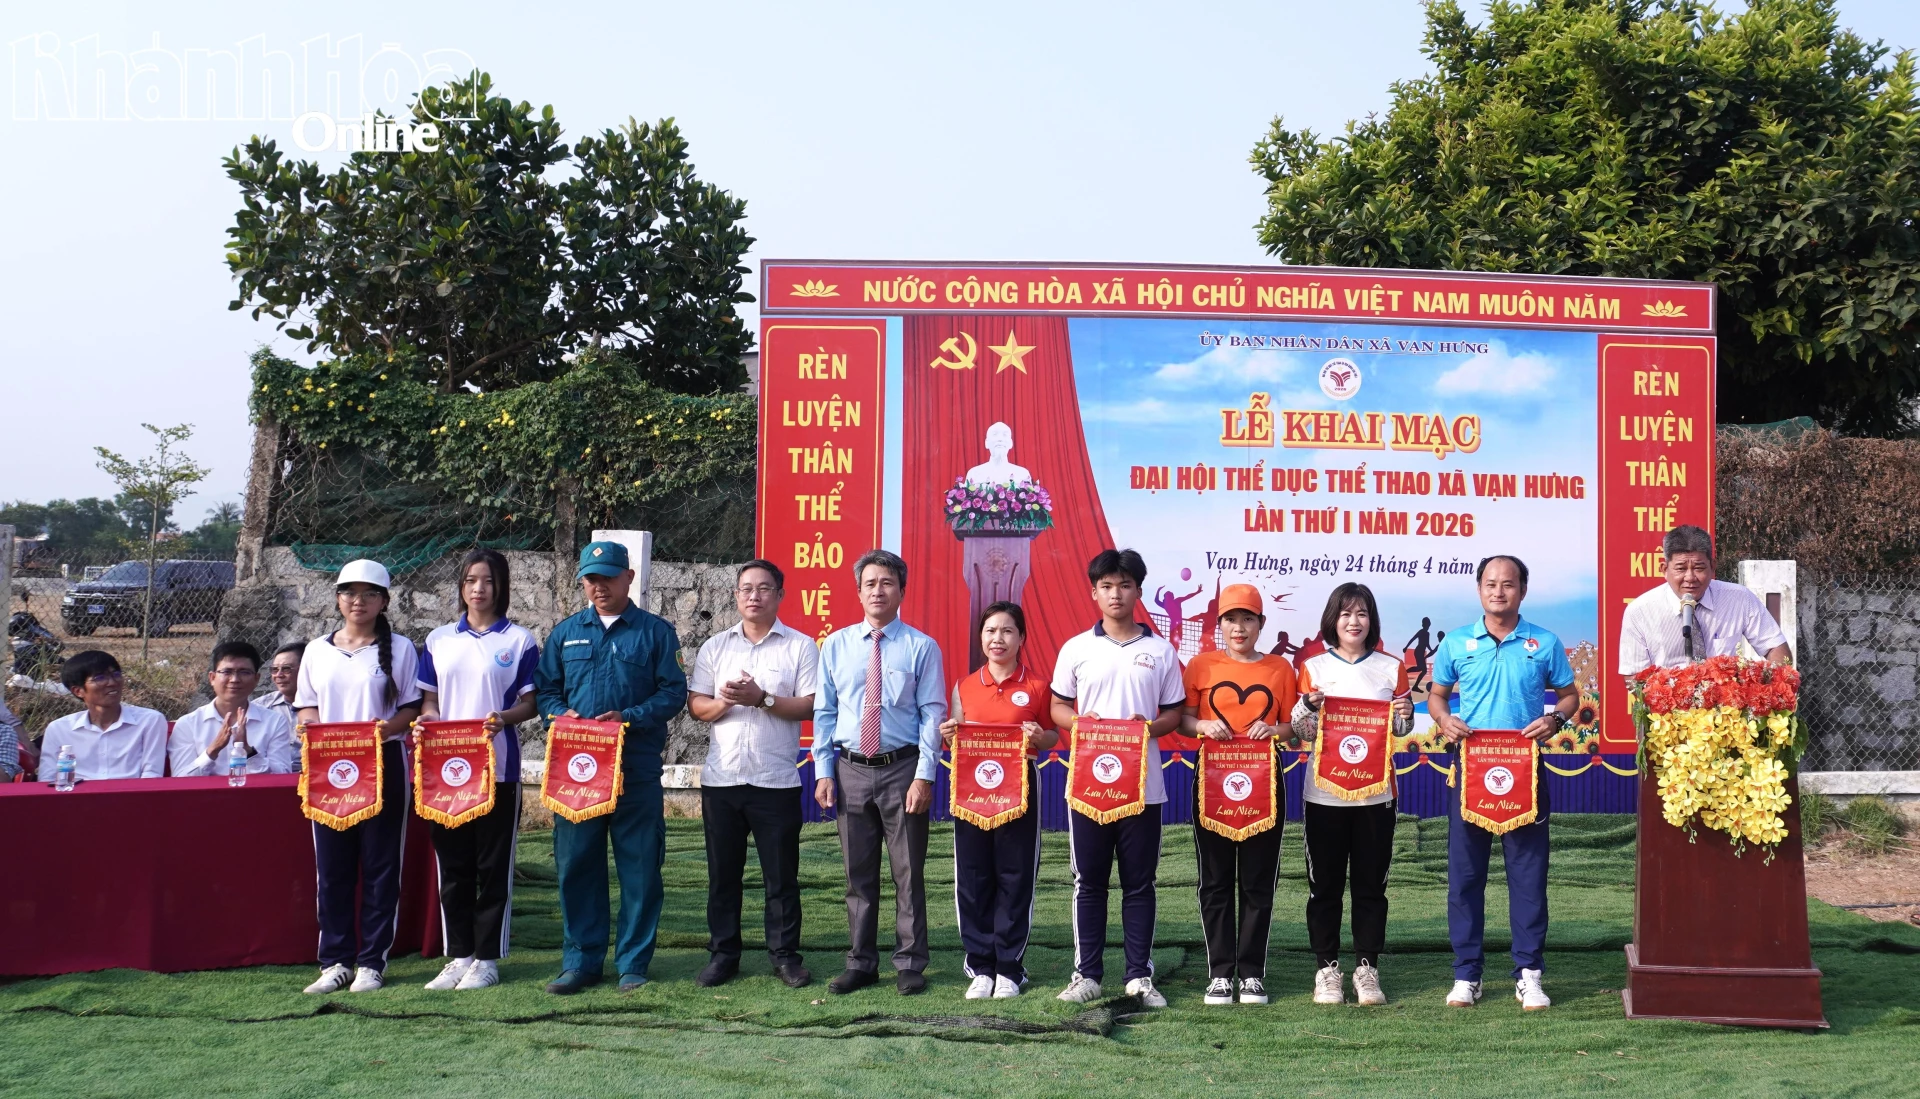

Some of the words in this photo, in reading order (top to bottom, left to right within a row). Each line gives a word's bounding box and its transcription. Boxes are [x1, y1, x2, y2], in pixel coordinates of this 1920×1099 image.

[863, 276, 936, 303] NƯỚC
[945, 275, 1018, 306] CỘNG
[1028, 276, 1083, 304] HÒA
[1091, 277, 1127, 305] XÃ
[1138, 277, 1182, 309] HỘI
[1192, 278, 1246, 307] CHỦ
[1257, 279, 1335, 310] NGHĨA
[1344, 283, 1402, 315] VIỆT
[1413, 288, 1470, 315] NAM
[1479, 290, 1555, 318] MUÔN
[1564, 293, 1621, 319] NĂM
[1200, 332, 1224, 347] ỦY
[1230, 336, 1266, 348] BAN
[1270, 335, 1322, 350] NHÂN
[1326, 336, 1365, 350] DÂN
[1369, 337, 1392, 351] XÃ
[1399, 340, 1435, 354] VẠN
[1439, 341, 1489, 355] HƯNG
[798, 347, 847, 380] RÈN
[1633, 366, 1680, 397] RÈN
[782, 394, 861, 432] LUYỆN
[1222, 392, 1274, 448] LỄ
[1281, 410, 1385, 450] KHAI
[1390, 414, 1481, 461] MẠC
[1620, 410, 1693, 447] LUYỆN
[788, 441, 853, 474] THÂN
[1626, 455, 1687, 487] THÂN
[1130, 466, 1171, 495] ĐẠI
[1176, 462, 1216, 495] HỘI
[1223, 459, 1264, 491] THỂ
[1271, 468, 1318, 496] DỤC
[1325, 462, 1367, 494] THỂ
[1373, 470, 1431, 496] THAO
[1438, 467, 1467, 496] XÃ
[1473, 473, 1516, 502] VẠN
[1524, 474, 1585, 500] HƯNG
[795, 481, 844, 521] THỂ
[1633, 494, 1680, 532] THỂ
[1244, 501, 1284, 533] LẦN
[1291, 505, 1339, 535] THỨ
[1343, 511, 1351, 534] I
[1359, 506, 1409, 536] NĂM
[1416, 511, 1476, 538] 2026
[794, 531, 844, 569] BẢO
[1205, 551, 1239, 574] Vạn
[1244, 552, 1293, 574] Hưng,
[1299, 553, 1340, 576] ngày
[1345, 554, 1364, 573] 24
[1369, 554, 1418, 578] tháng
[1423, 556, 1433, 574] 4
[1438, 558, 1475, 575] năm
[801, 583, 831, 622] VỆ
[984, 793, 1011, 807] Niệm
[1103, 786, 1128, 802] Niệm
[1234, 805, 1260, 818] Niệm
[1495, 799, 1521, 812] Niệm
